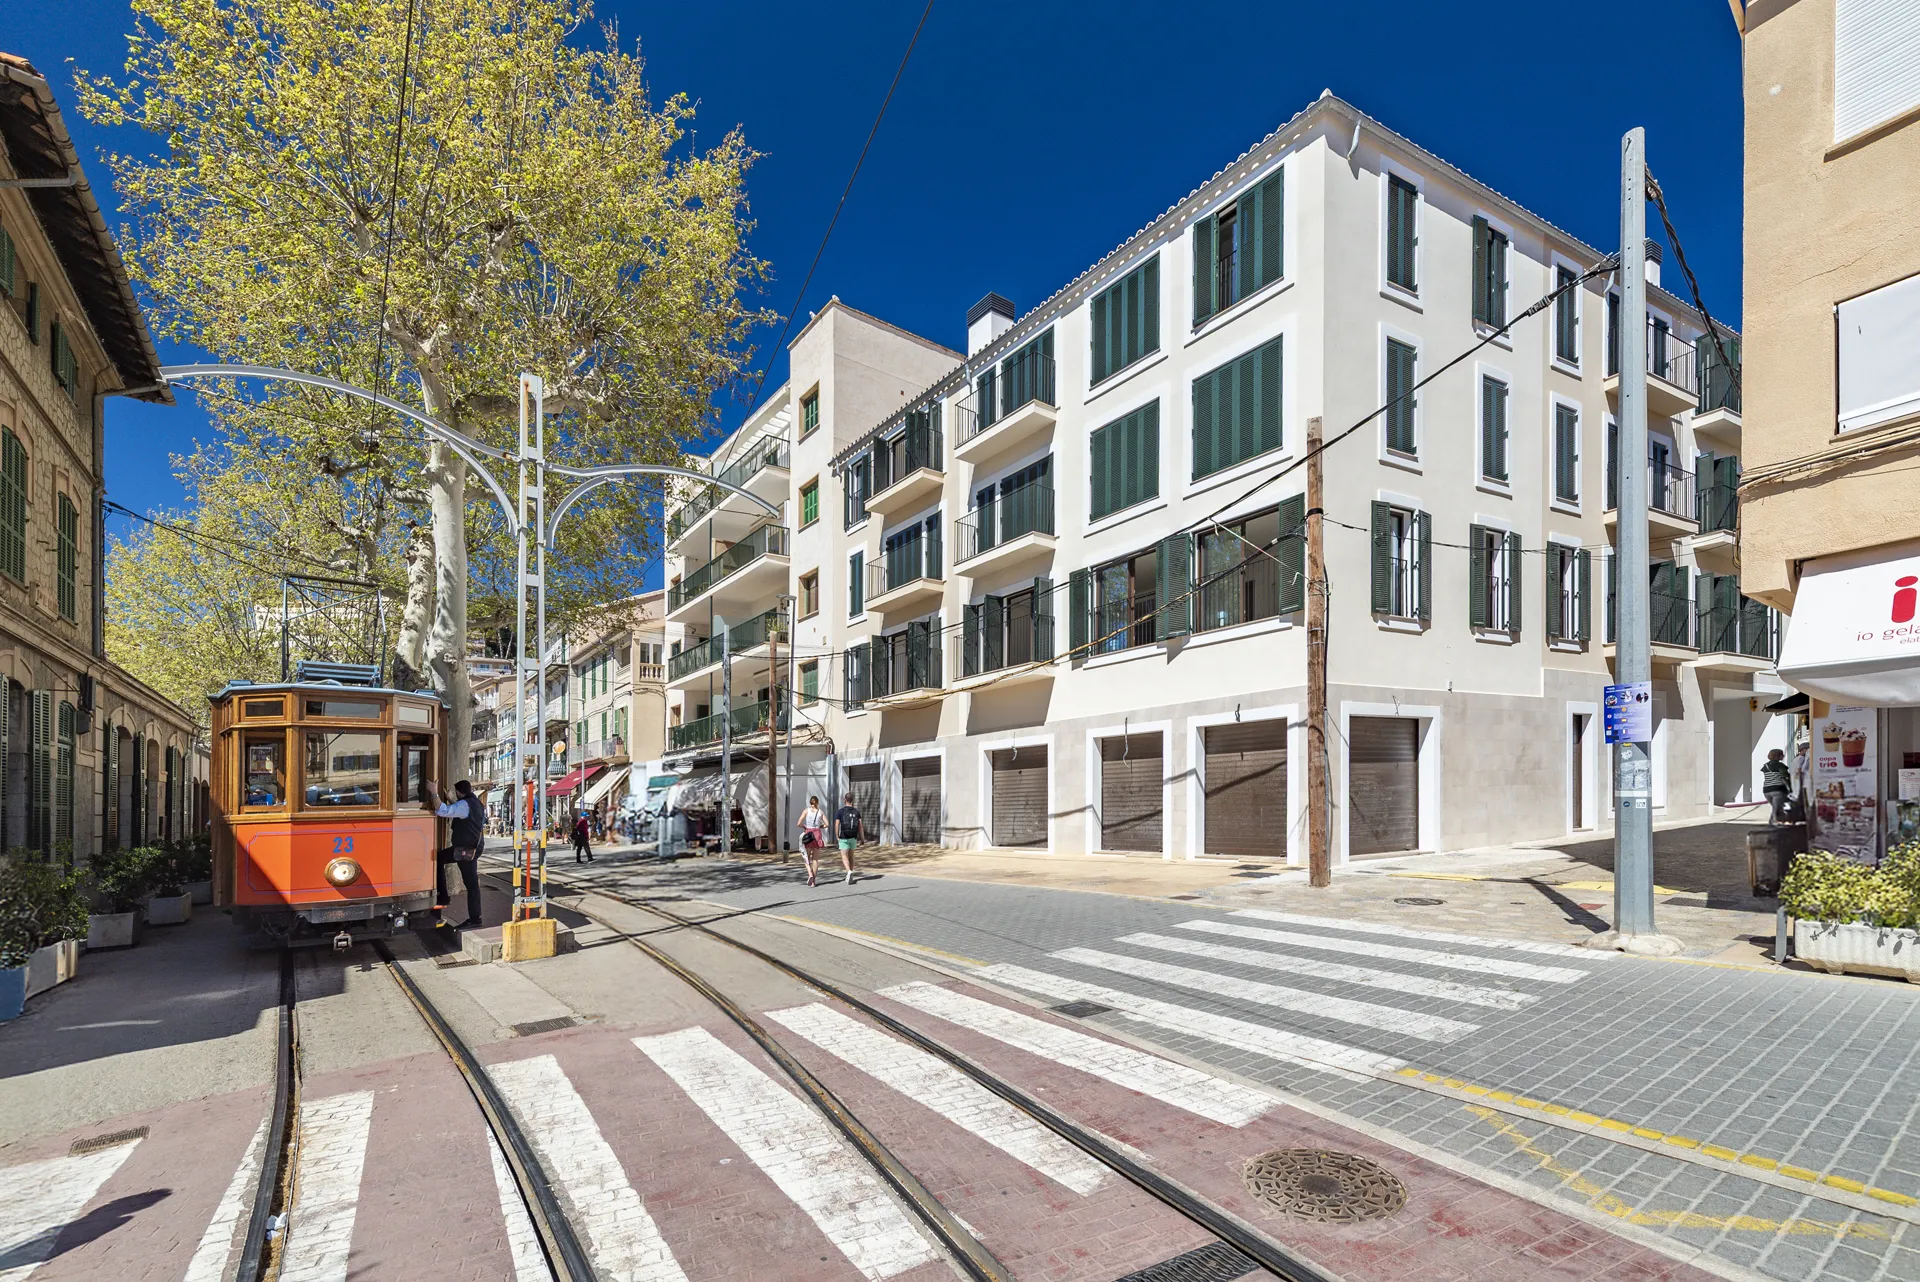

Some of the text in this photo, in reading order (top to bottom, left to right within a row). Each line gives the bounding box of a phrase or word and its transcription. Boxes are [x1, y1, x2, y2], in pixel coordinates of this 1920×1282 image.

[1857, 631, 1874, 641] io
[333, 836, 353, 853] 23
[1268, 1189, 1327, 1215] BENITO
